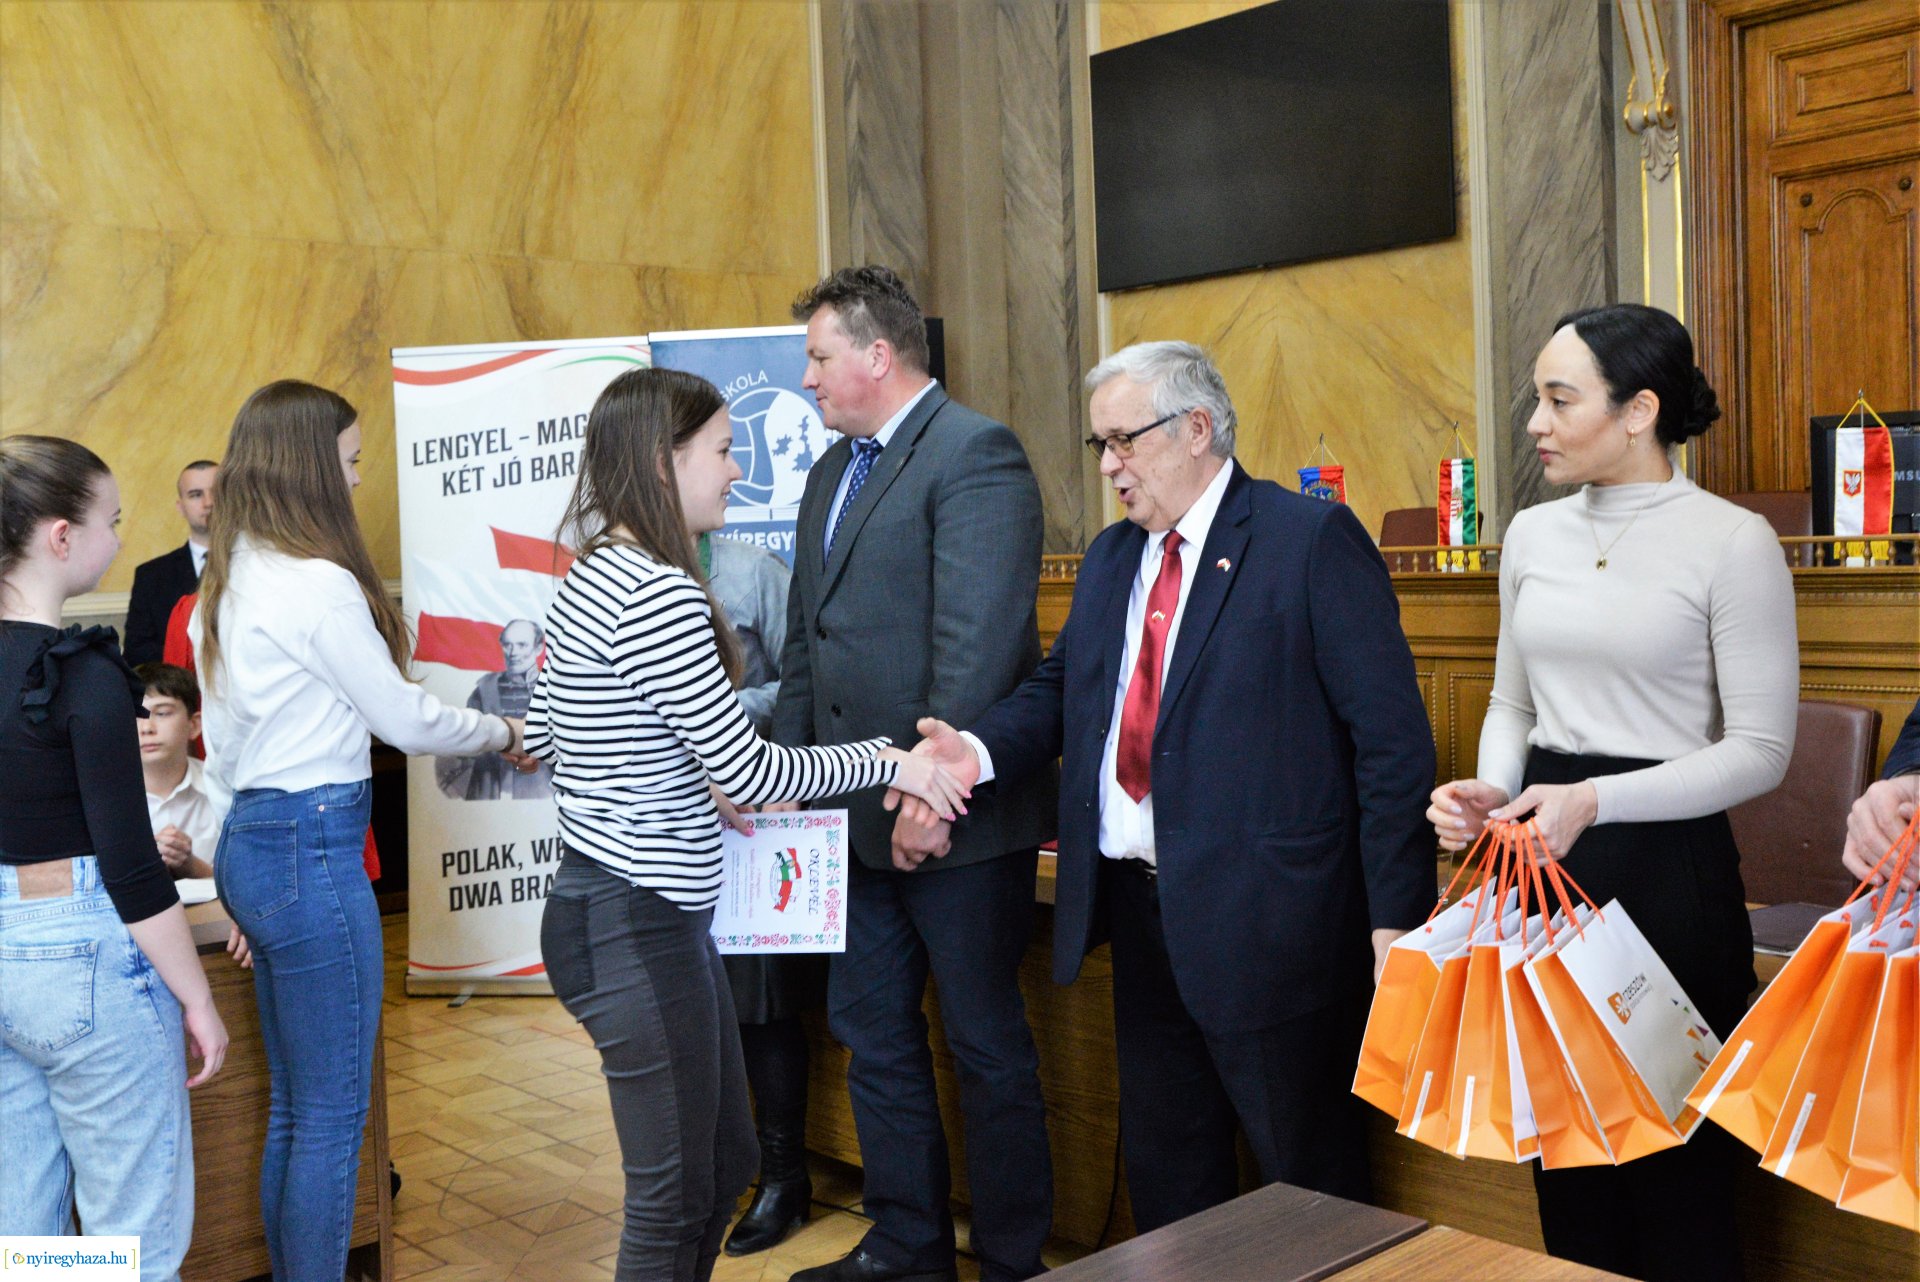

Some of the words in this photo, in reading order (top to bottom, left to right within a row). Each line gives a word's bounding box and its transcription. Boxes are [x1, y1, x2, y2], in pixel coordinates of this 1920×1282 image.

[413, 427, 512, 466] LENGYEL
[537, 412, 589, 446] MAG
[442, 460, 485, 497] KÉT
[493, 456, 522, 488] JÓ
[442, 843, 523, 878] POLAK,
[449, 880, 503, 912] DWA
[511, 873, 554, 903] BRA
[808, 848, 821, 915] OKLEVÉL
